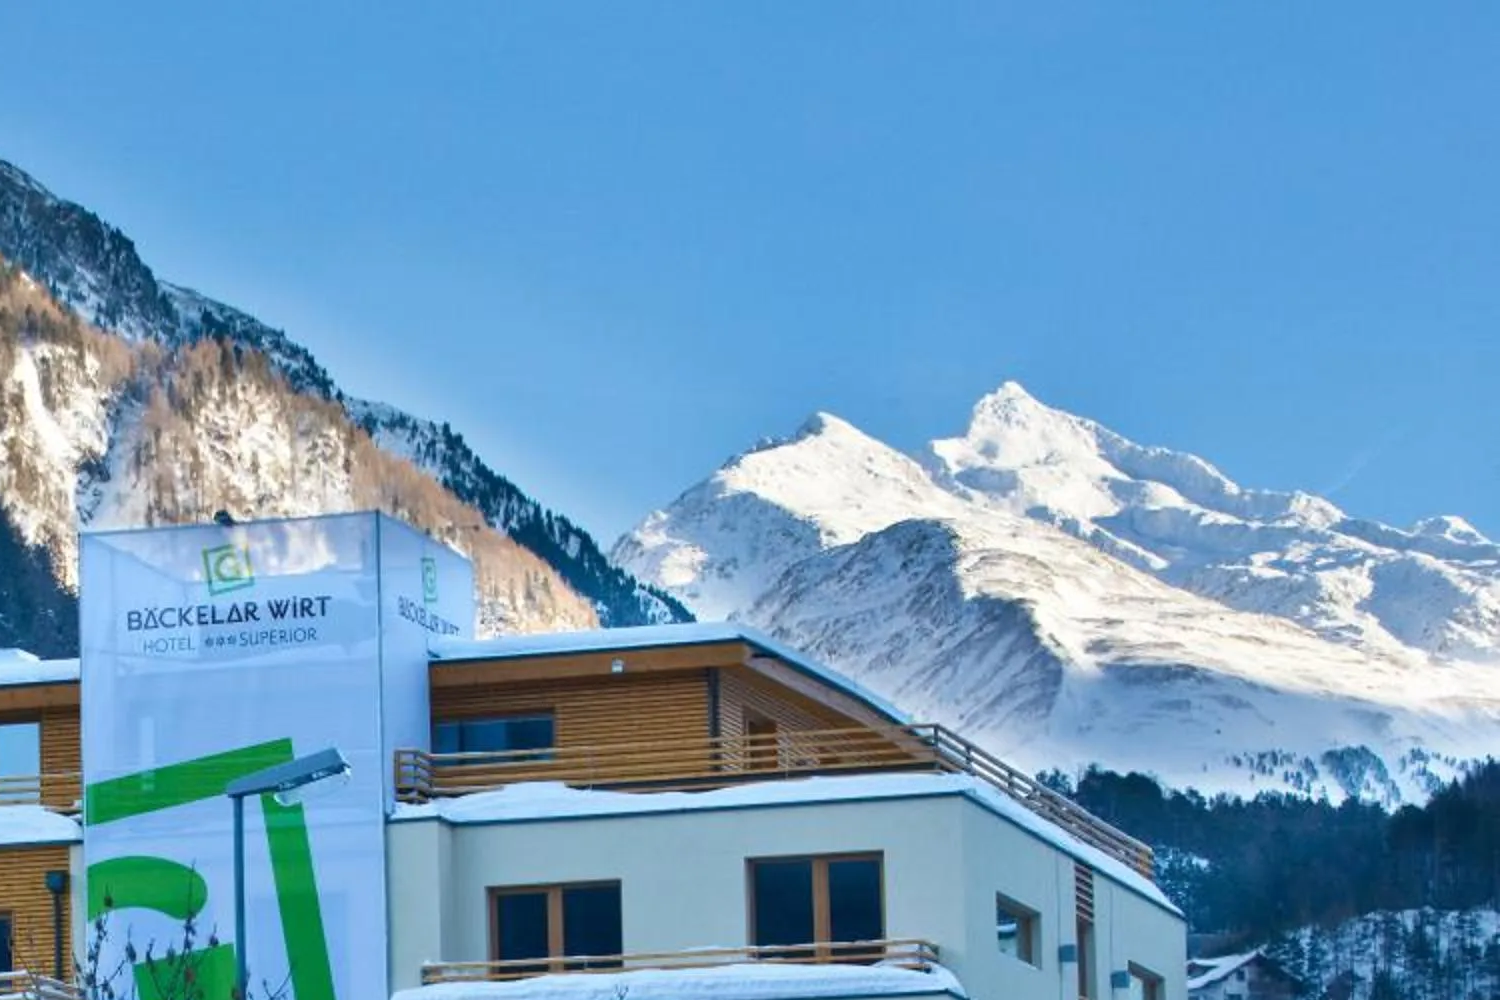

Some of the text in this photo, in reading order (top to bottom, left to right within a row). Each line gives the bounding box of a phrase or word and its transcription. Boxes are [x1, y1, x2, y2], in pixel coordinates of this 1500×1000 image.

[127, 596, 332, 631] BÄCKELAR WIRT
[143, 627, 317, 654] HOTEL SUPERIOR
